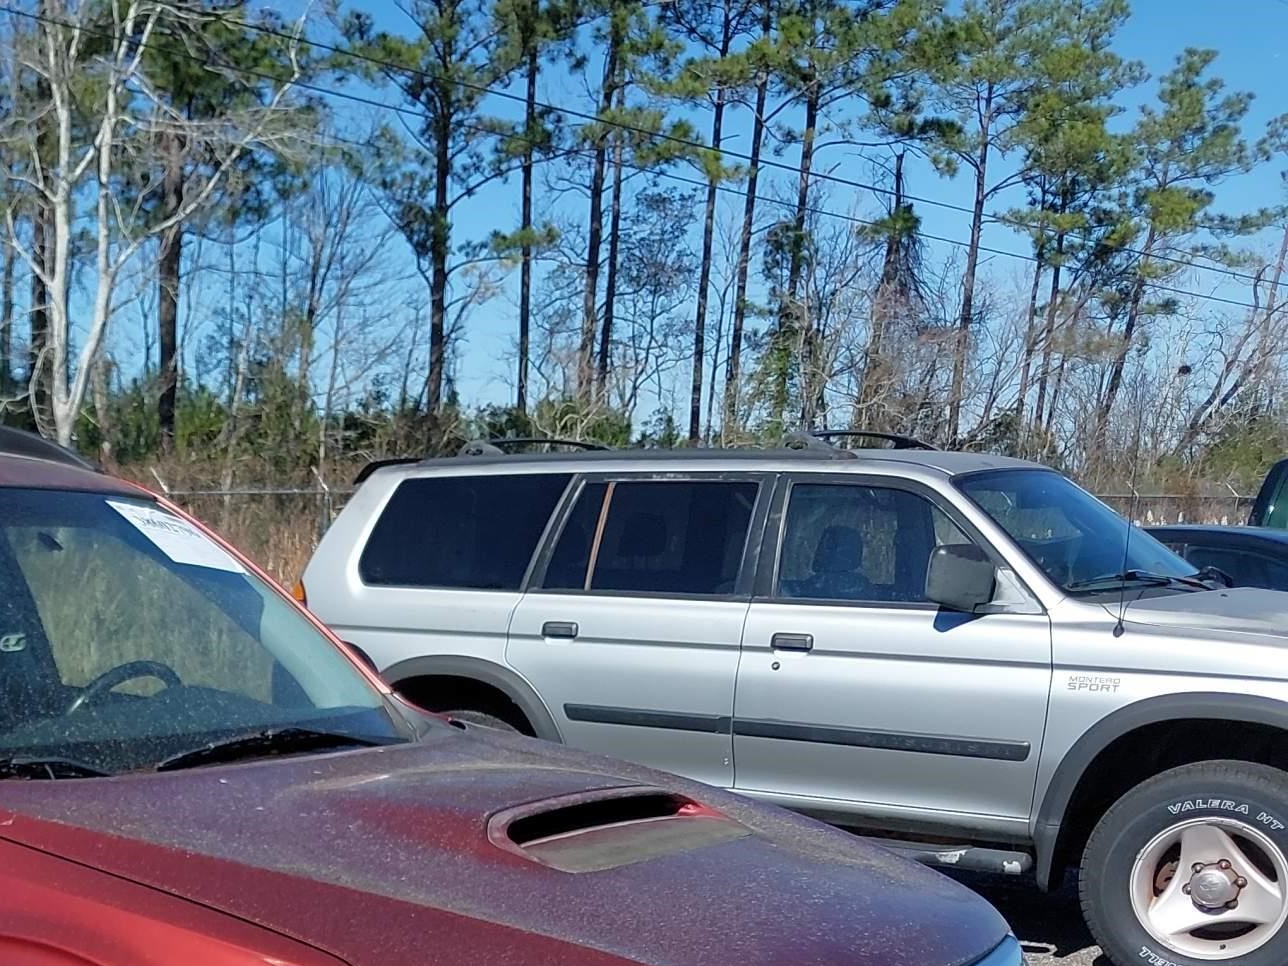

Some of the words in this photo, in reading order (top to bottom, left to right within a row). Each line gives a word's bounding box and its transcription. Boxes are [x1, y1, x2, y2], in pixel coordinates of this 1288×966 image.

[1069, 676, 1120, 684] MONTERO
[1067, 683, 1120, 692] SPORT
[1167, 799, 1249, 816] VALERA
[1256, 811, 1284, 830] HT
